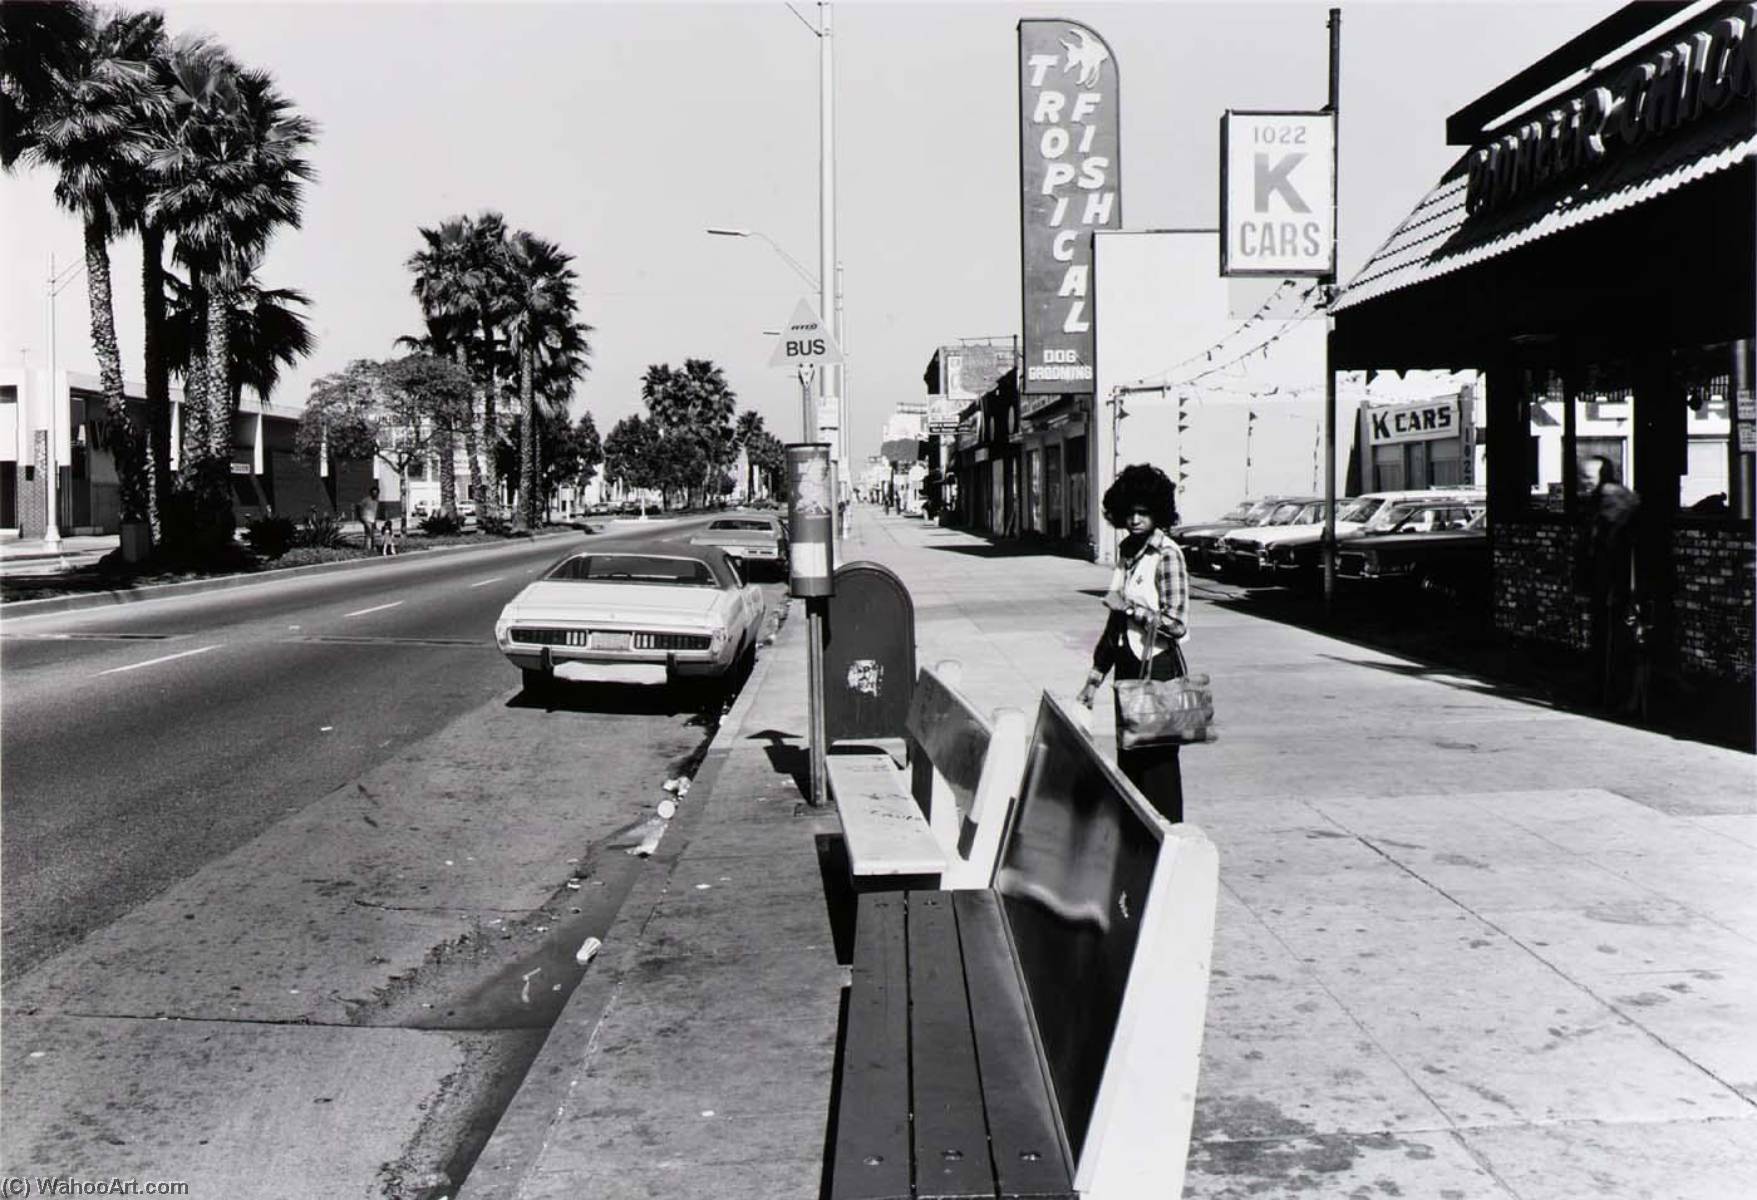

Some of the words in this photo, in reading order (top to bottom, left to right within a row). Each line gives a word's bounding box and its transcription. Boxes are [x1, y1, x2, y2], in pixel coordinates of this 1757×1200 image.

[1254, 125, 1307, 145] 1022
[1071, 92, 1115, 225] FISH
[1028, 54, 1090, 334] TROPICAL
[1253, 151, 1313, 214] K
[1240, 221, 1321, 257] CARS
[786, 338, 826, 357] BUS
[1043, 348, 1077, 364] DOG
[1028, 366, 1093, 381] GROOMING
[1372, 410, 1391, 439] K
[1394, 405, 1451, 433] CARS
